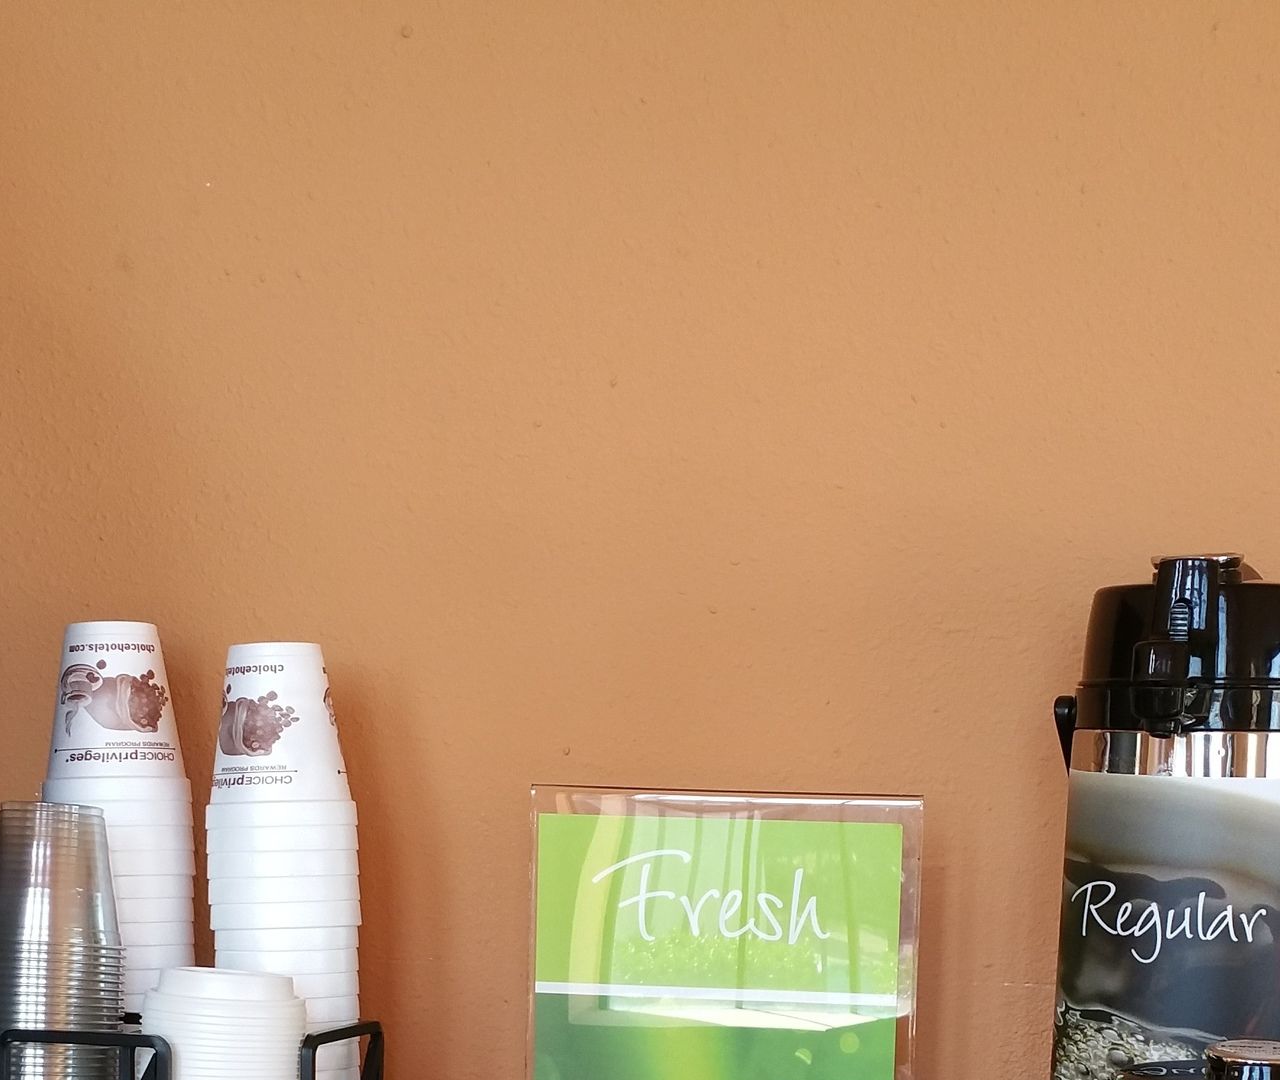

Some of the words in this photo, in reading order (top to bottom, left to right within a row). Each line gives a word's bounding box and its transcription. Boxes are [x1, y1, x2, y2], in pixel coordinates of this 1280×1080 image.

[68, 642, 156, 653] choicehotels.com
[591, 848, 831, 945] Fresh
[1070, 880, 1268, 964] Regular
